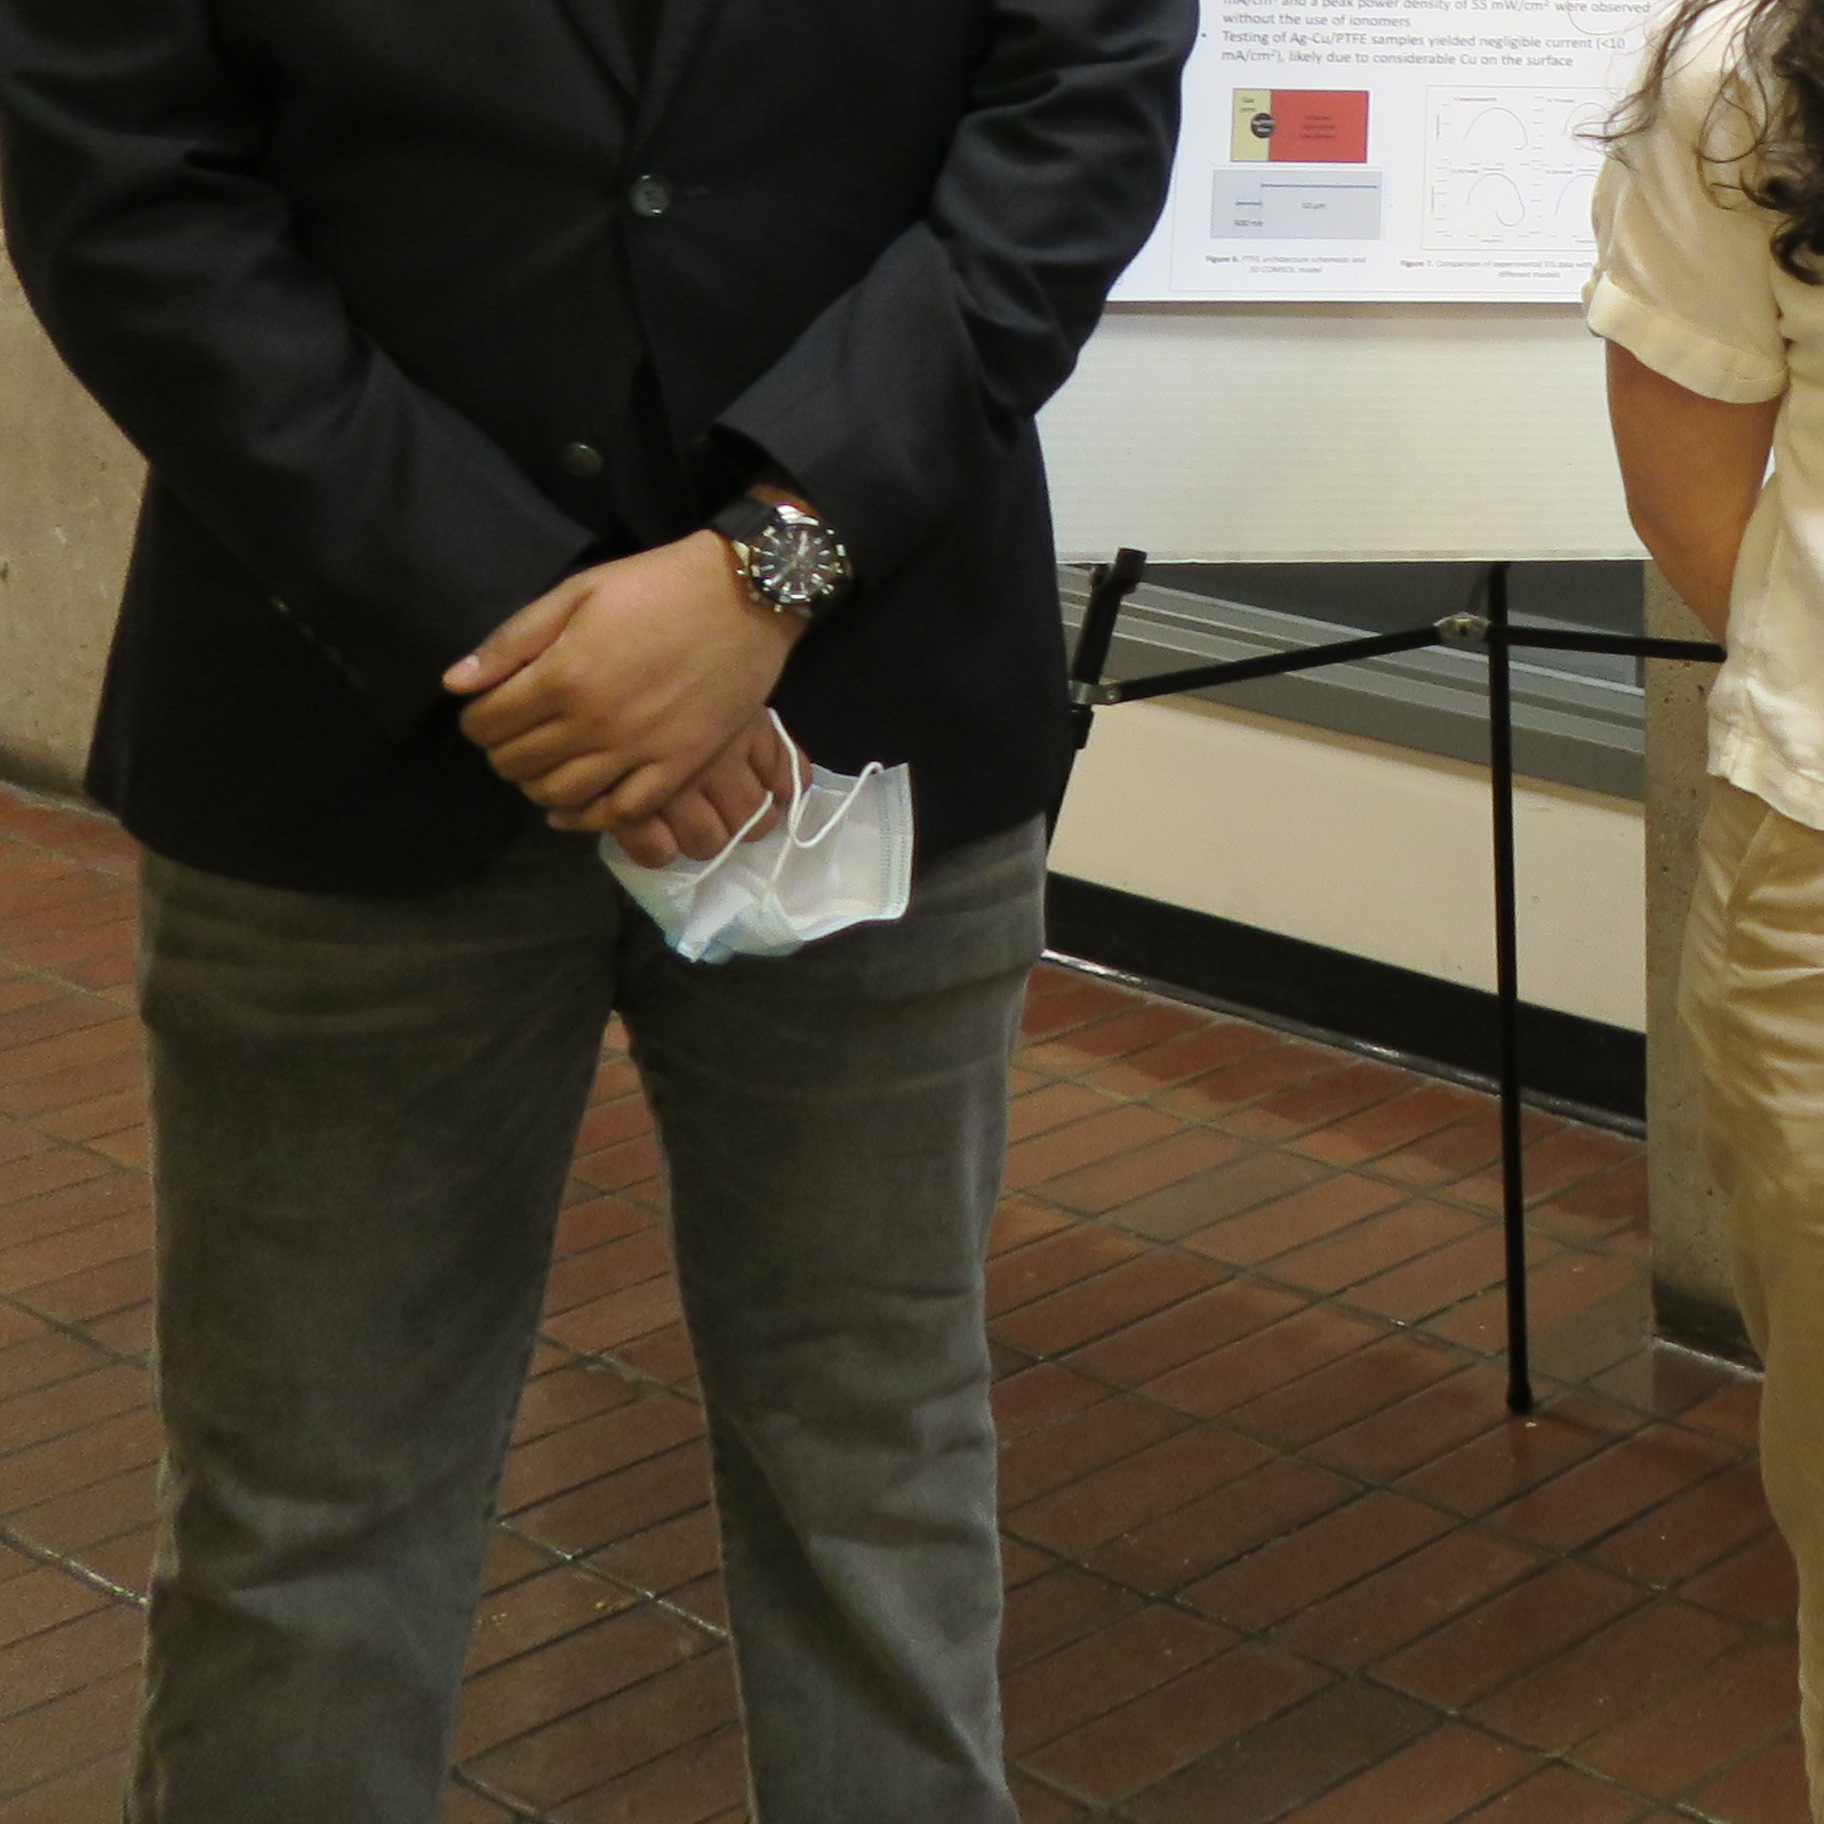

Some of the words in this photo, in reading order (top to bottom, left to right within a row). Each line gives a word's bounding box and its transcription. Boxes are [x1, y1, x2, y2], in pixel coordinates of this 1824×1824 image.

[1222, 12, 1275, 24] without
[1278, 13, 1301, 25] the
[1305, 16, 1328, 25] use
[1332, 14, 1345, 25] of
